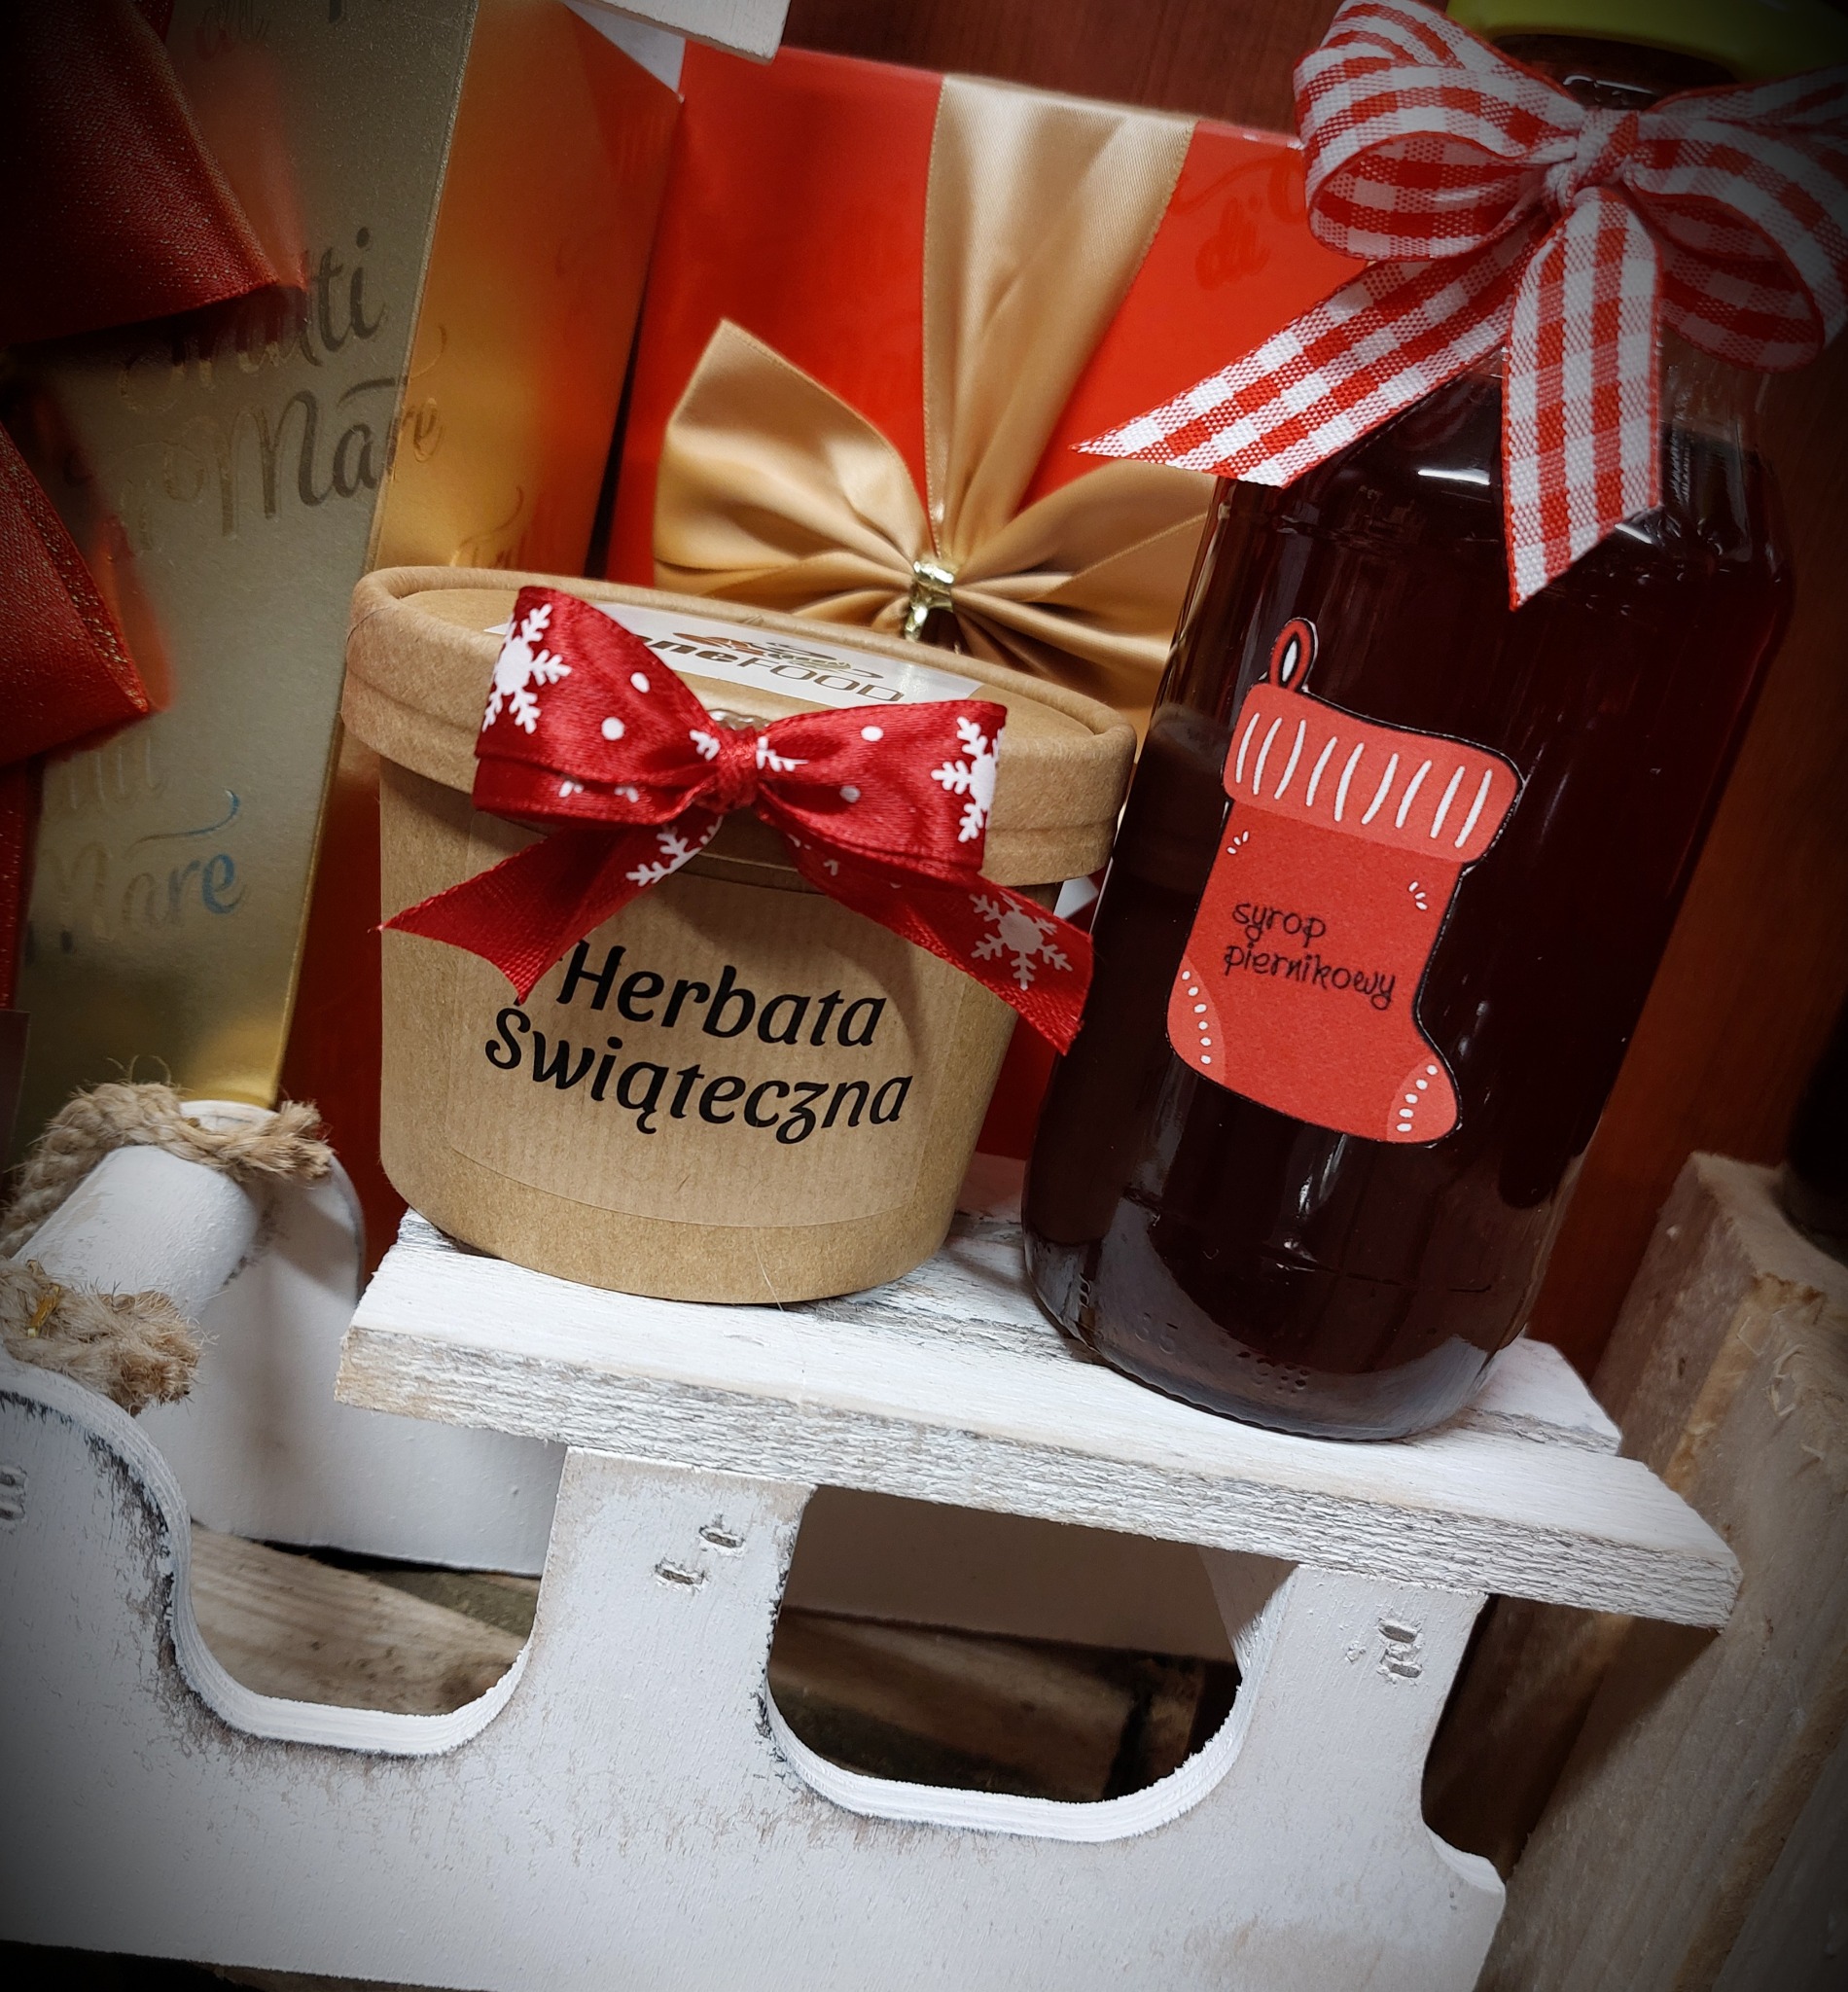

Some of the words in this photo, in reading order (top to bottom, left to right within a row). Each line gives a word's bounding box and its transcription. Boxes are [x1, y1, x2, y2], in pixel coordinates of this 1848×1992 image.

[1232, 903, 1326, 948] syrop
[555, 939, 887, 1048] Herbata
[1224, 943, 1396, 1011] piernikowy
